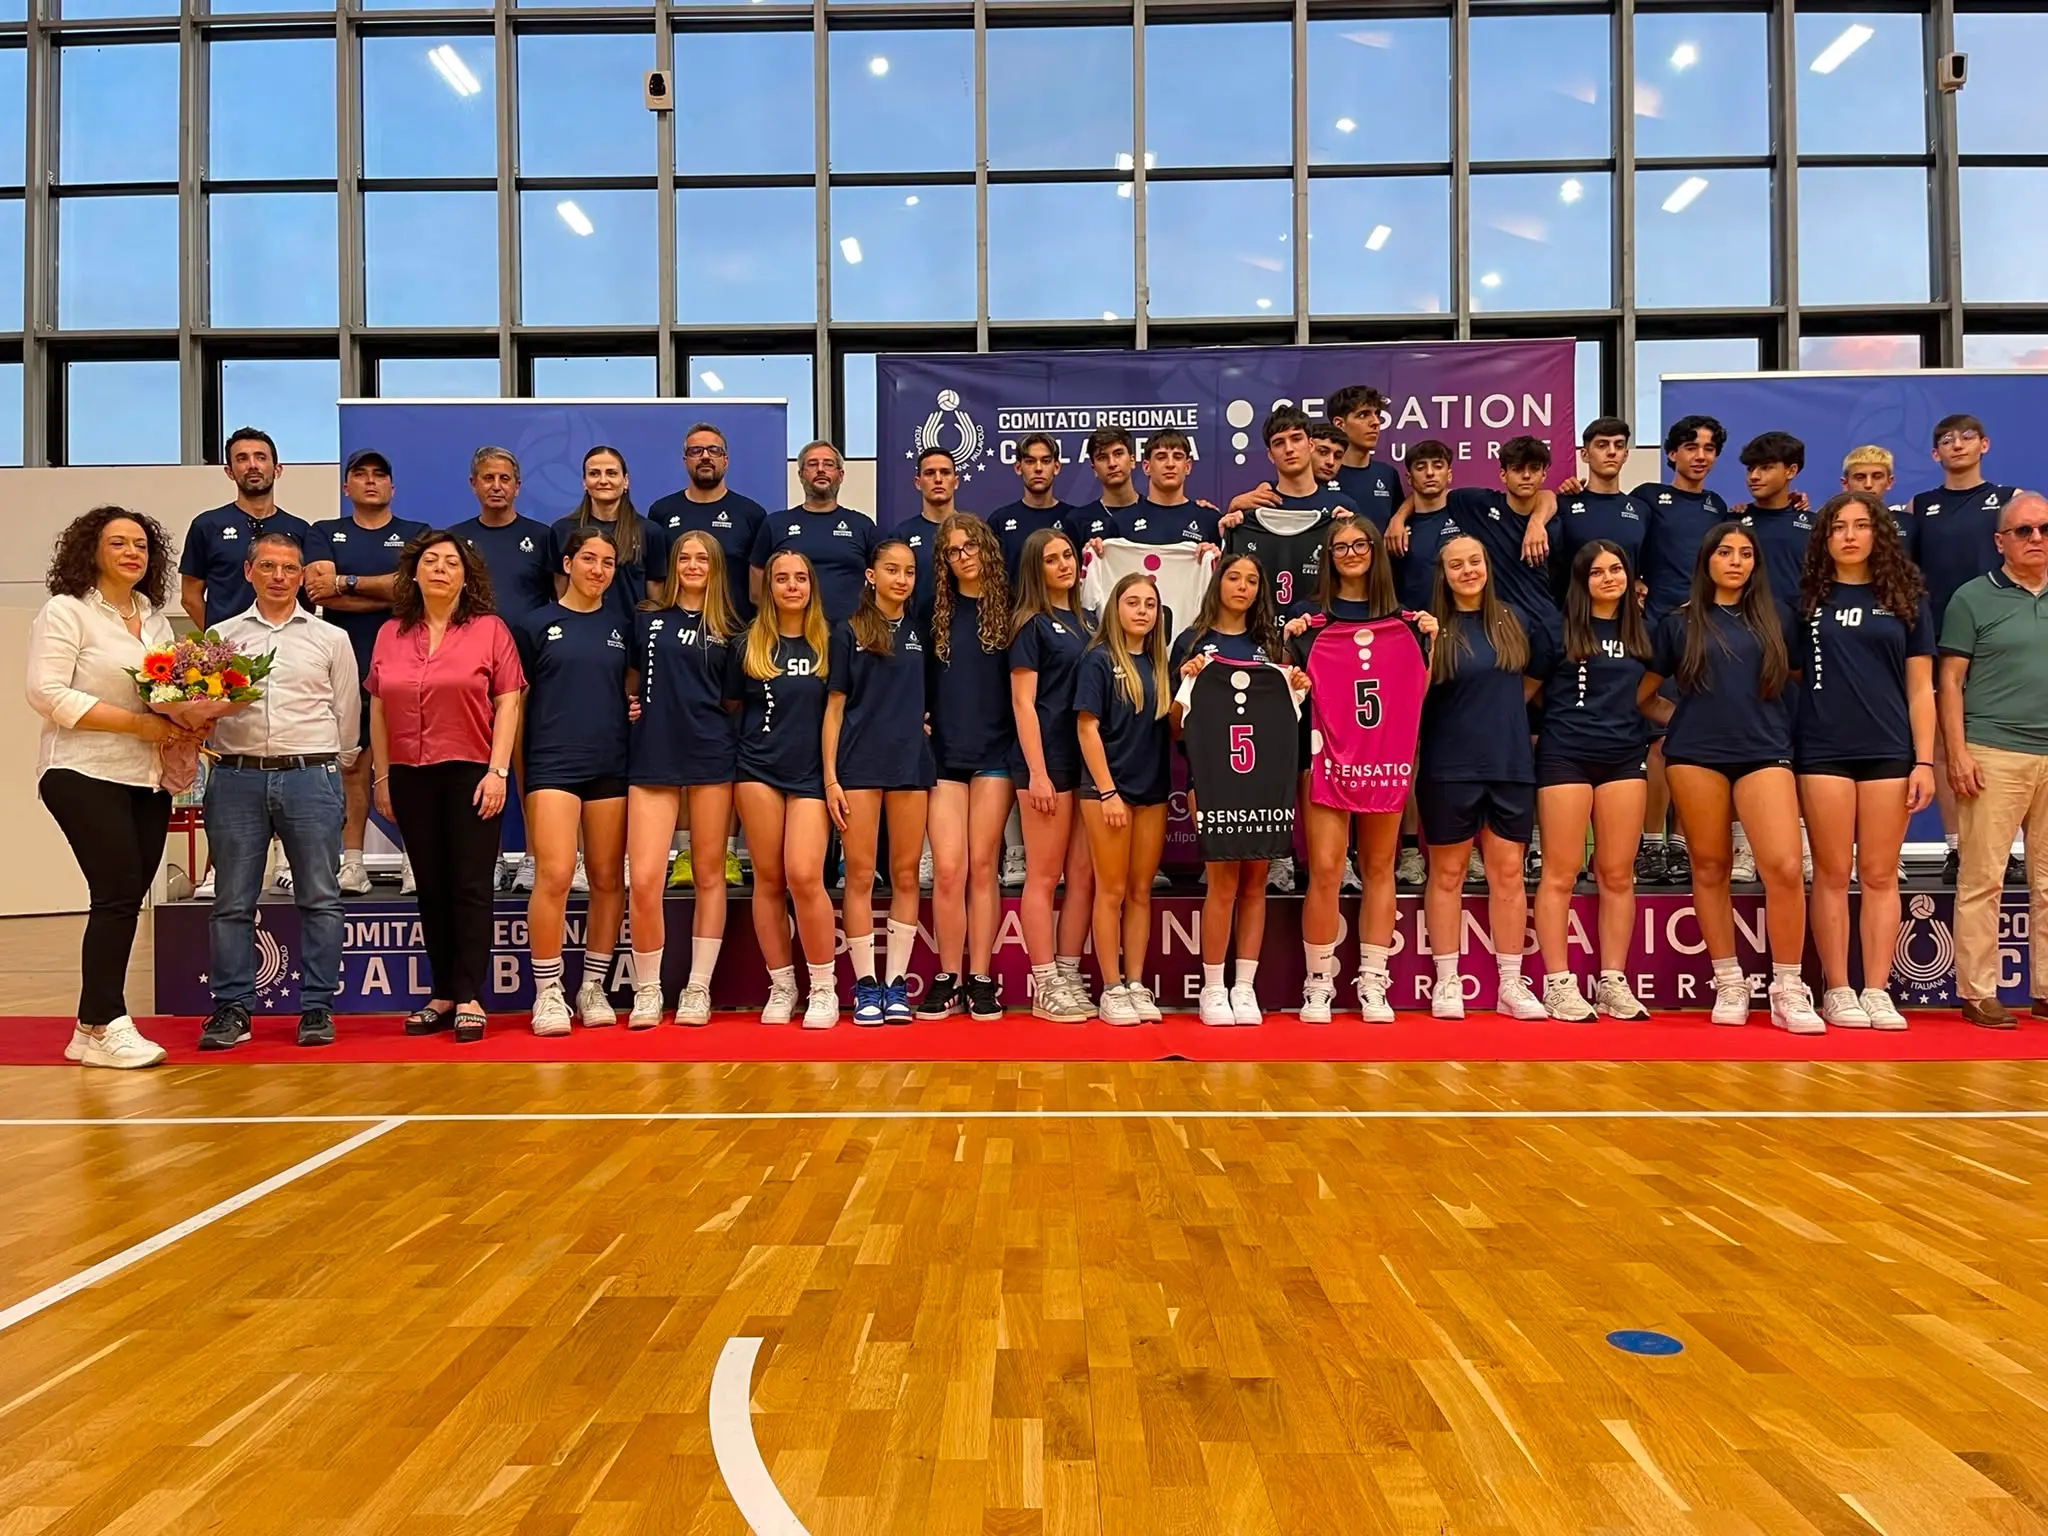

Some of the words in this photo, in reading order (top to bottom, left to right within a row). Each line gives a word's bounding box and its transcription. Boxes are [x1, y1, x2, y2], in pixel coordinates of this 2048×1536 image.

[999, 411, 1090, 430] COMITATO
[1096, 409, 1198, 428] REGIONALE
[1276, 571, 1294, 604] 3
[1835, 607, 1862, 627] 40
[677, 628, 697, 645] 41
[787, 658, 810, 676] 50
[1354, 678, 1383, 729] 5
[1229, 725, 1256, 774] 5
[1206, 808, 1295, 824] SENSATION
[1910, 977, 1947, 991] ITALIANA
